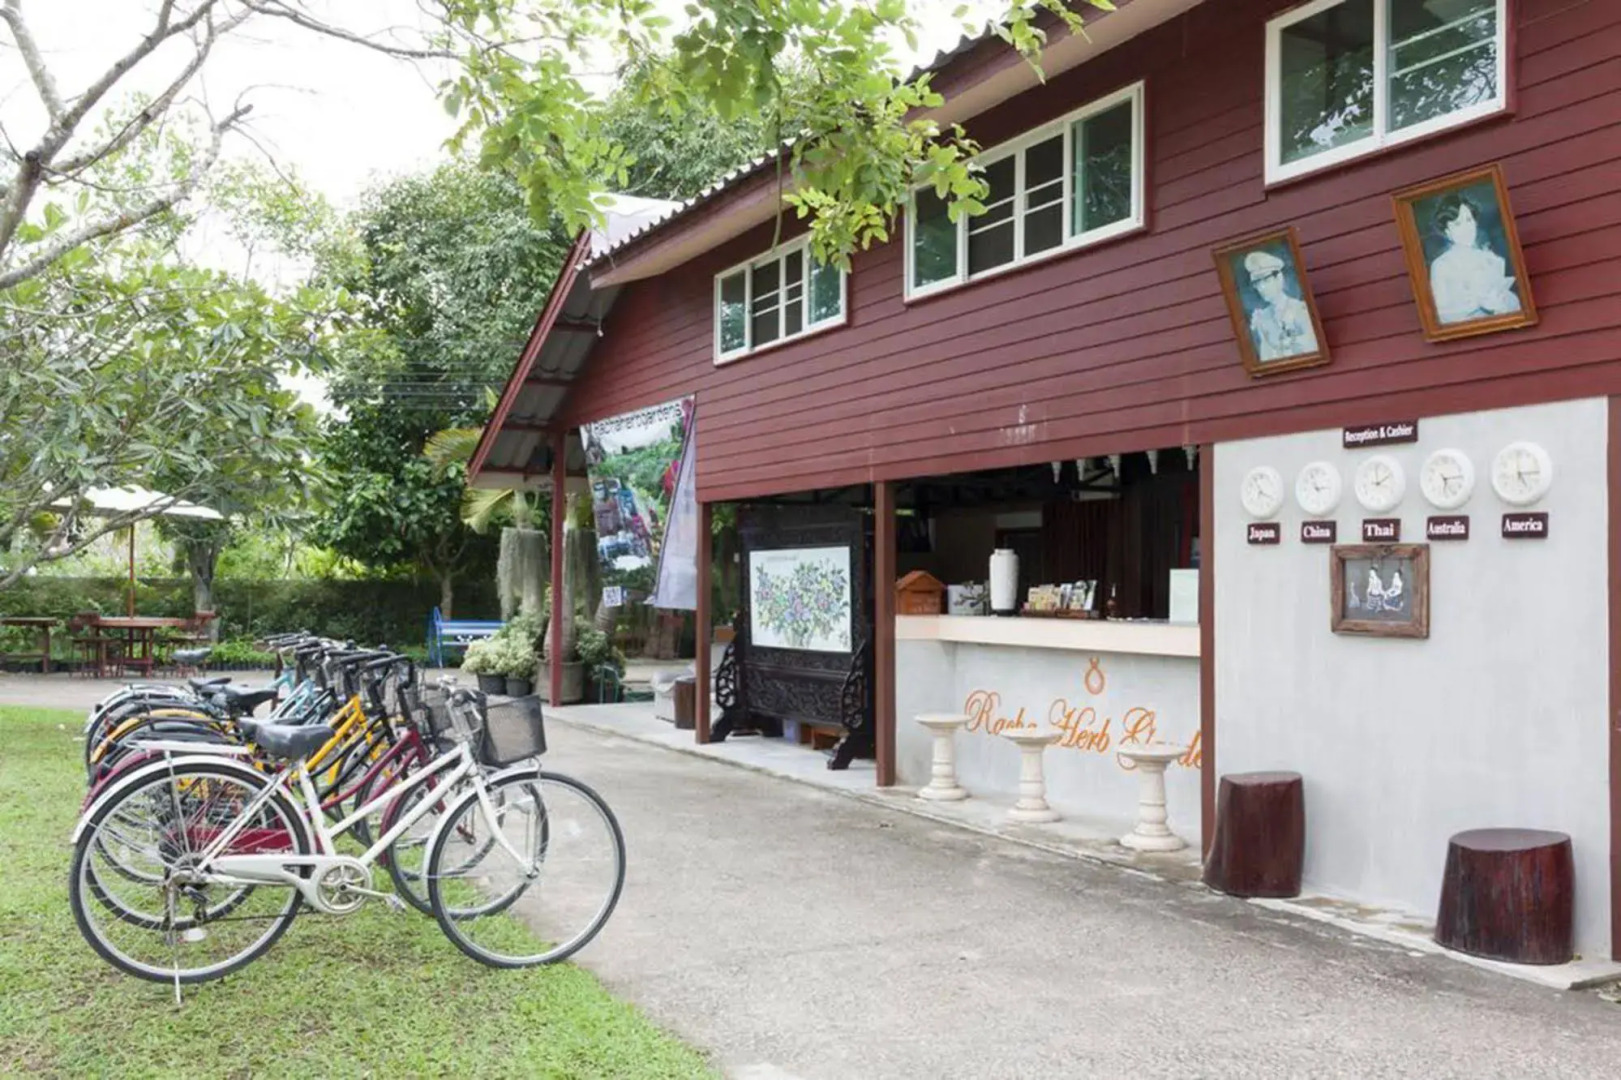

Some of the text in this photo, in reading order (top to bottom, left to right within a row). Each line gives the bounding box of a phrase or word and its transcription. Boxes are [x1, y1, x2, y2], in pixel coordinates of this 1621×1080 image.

[1345, 424, 1414, 443] Reception & Cashier
[1303, 525, 1331, 538] China
[1365, 523, 1394, 537] Thai
[1428, 521, 1466, 535] Australia
[1504, 518, 1543, 532] America
[1250, 527, 1275, 541] Japan
[965, 690, 1038, 736] Rach
[1049, 699, 1111, 753] Herb
